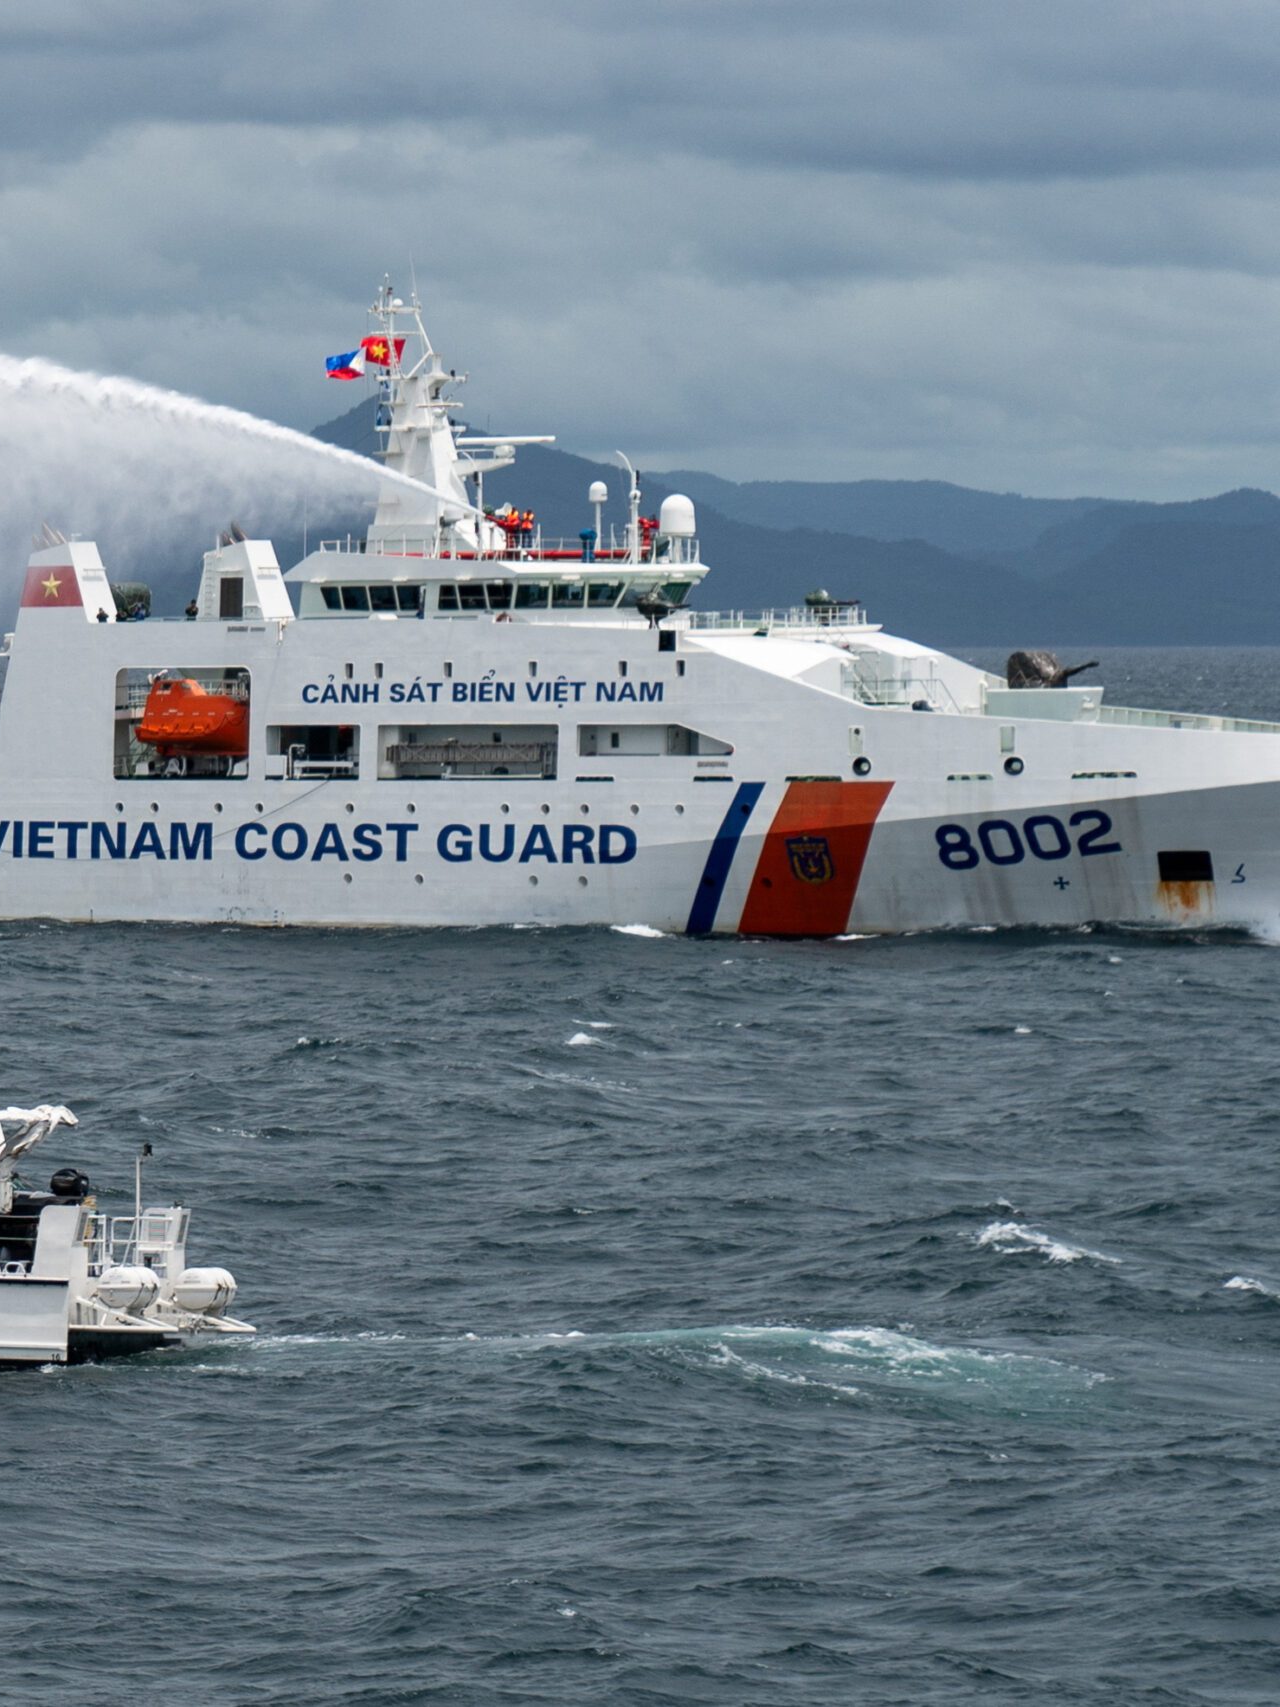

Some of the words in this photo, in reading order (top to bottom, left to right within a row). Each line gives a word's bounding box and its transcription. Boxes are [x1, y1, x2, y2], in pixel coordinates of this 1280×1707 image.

[302, 674, 380, 704] CẢNH
[389, 676, 443, 704] SÁT
[451, 669, 516, 704] BIỂN
[525, 675, 587, 709] VIỆT
[596, 681, 664, 703] NAM
[235, 822, 419, 863] COAST
[437, 823, 638, 865] GUARD
[935, 809, 1122, 871] 8002
